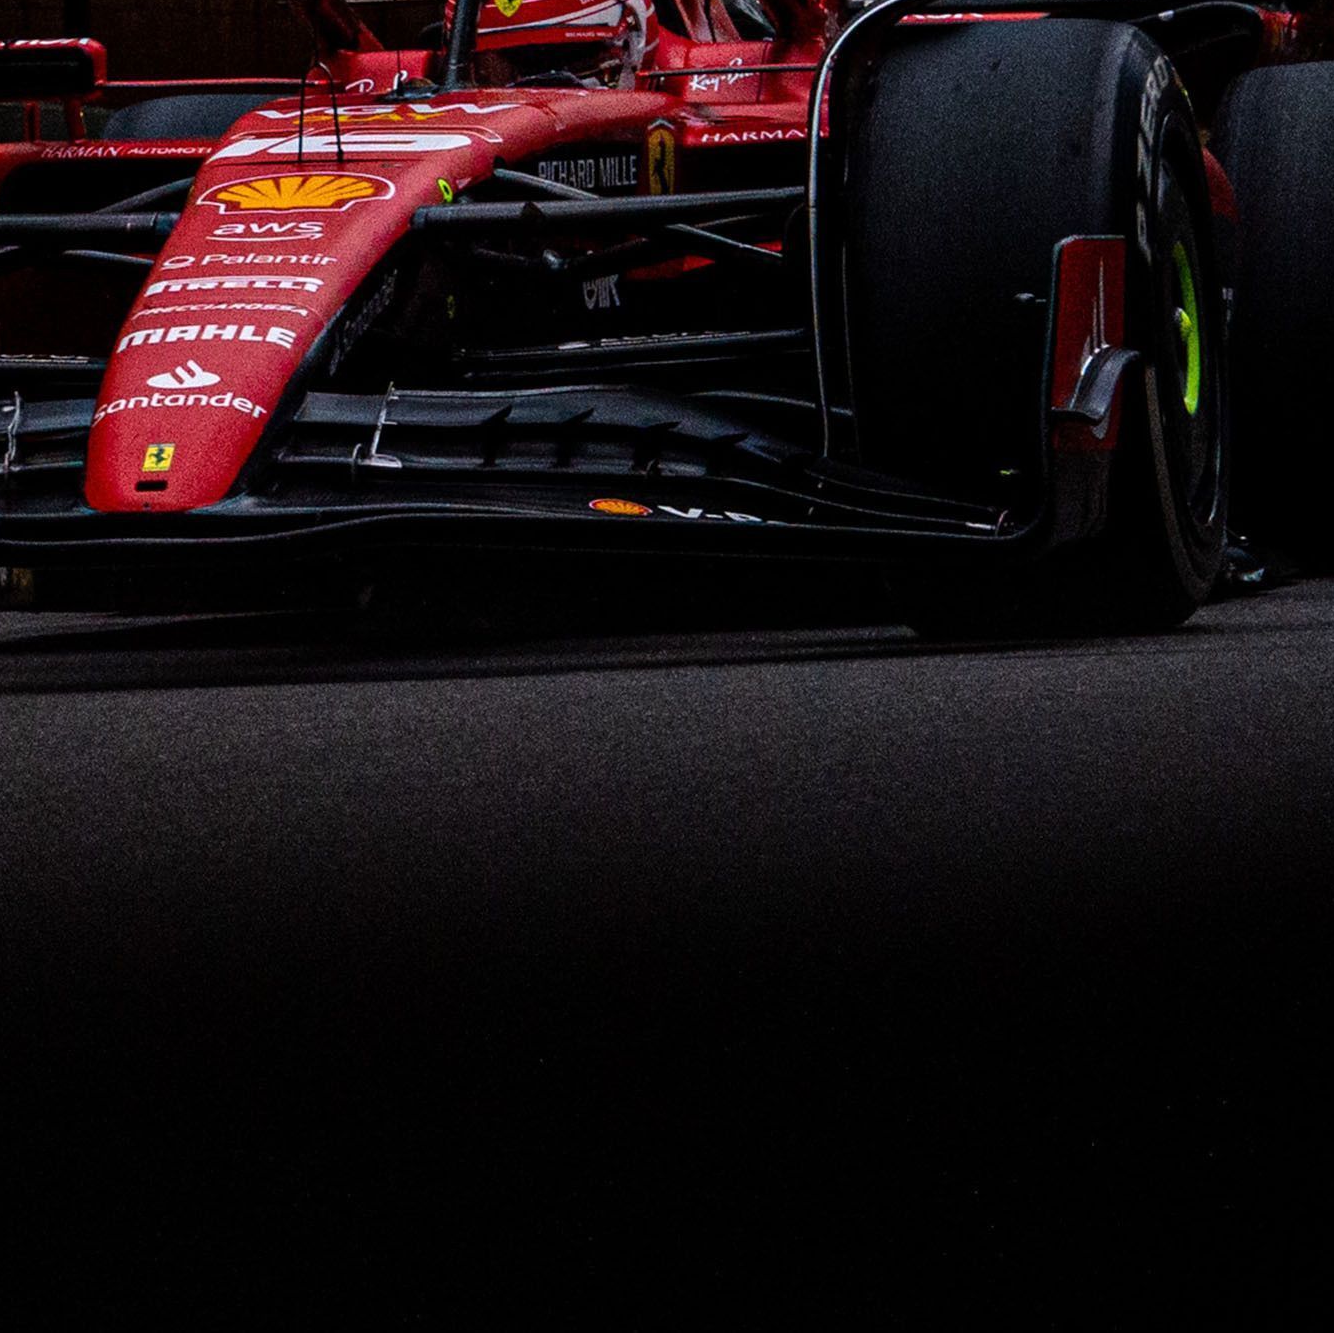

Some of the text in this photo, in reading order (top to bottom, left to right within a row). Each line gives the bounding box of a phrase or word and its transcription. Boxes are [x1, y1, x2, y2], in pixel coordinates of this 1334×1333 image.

[40, 145, 118, 160] HARMAN
[598, 154, 638, 188] MILLE
[213, 221, 325, 236] aws
[201, 252, 338, 267] Palantir
[144, 274, 325, 298] PIRELLI
[116, 323, 297, 354] MAHLE
